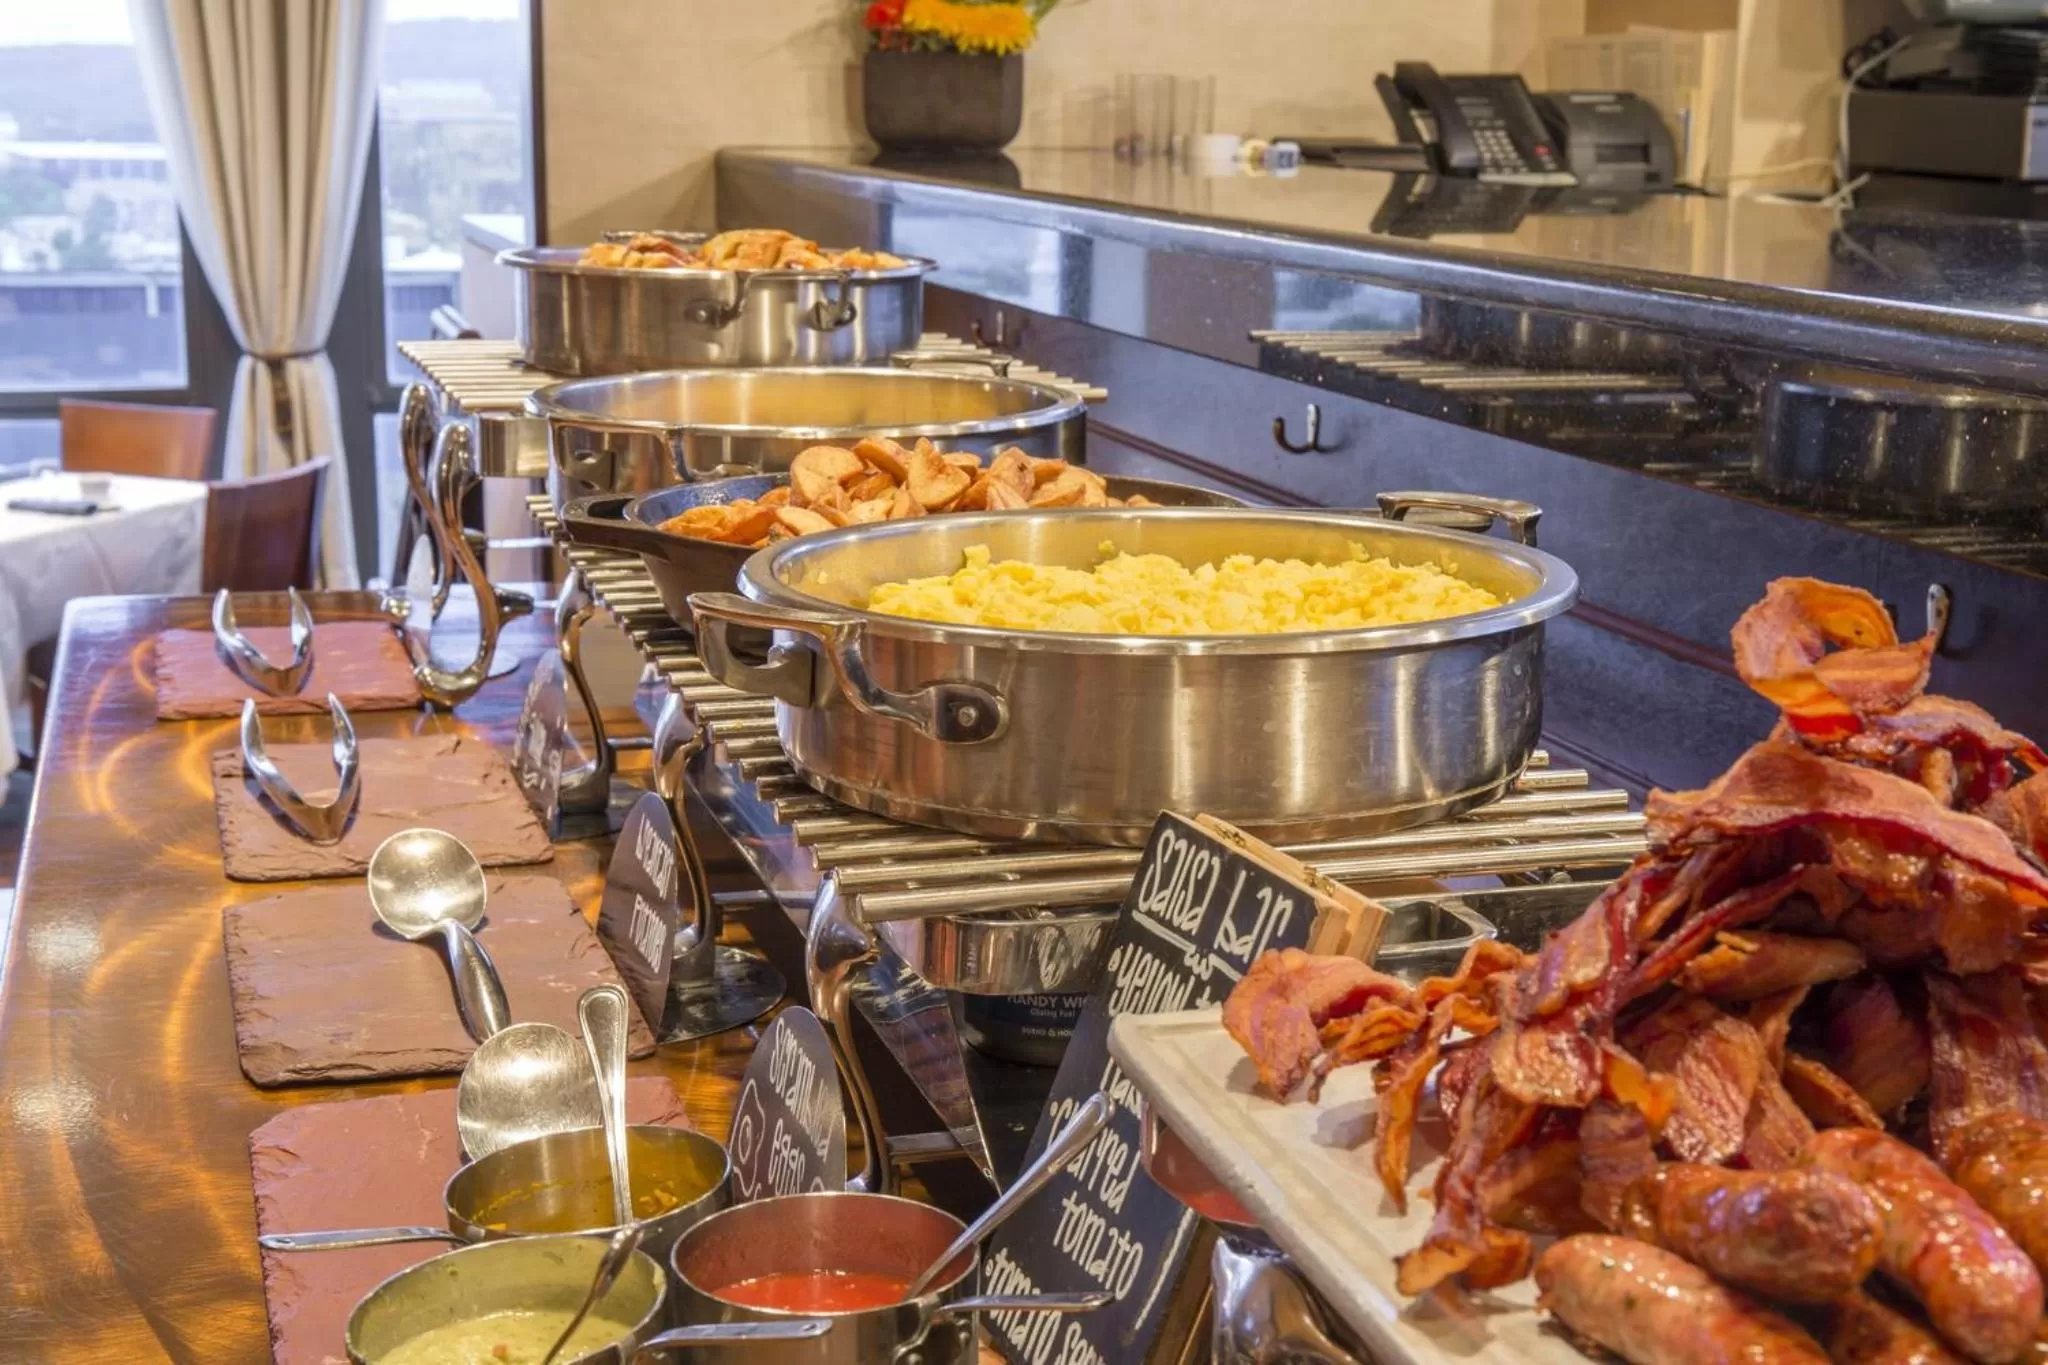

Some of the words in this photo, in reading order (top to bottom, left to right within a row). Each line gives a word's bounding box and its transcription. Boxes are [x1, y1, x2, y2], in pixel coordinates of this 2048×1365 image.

[1138, 828, 1221, 936] Salsa
[1213, 869, 1294, 964] bar
[1007, 995, 1058, 1009] HANDY
[1047, 1097, 1142, 1215] Carred
[1053, 1190, 1144, 1301] tomato
